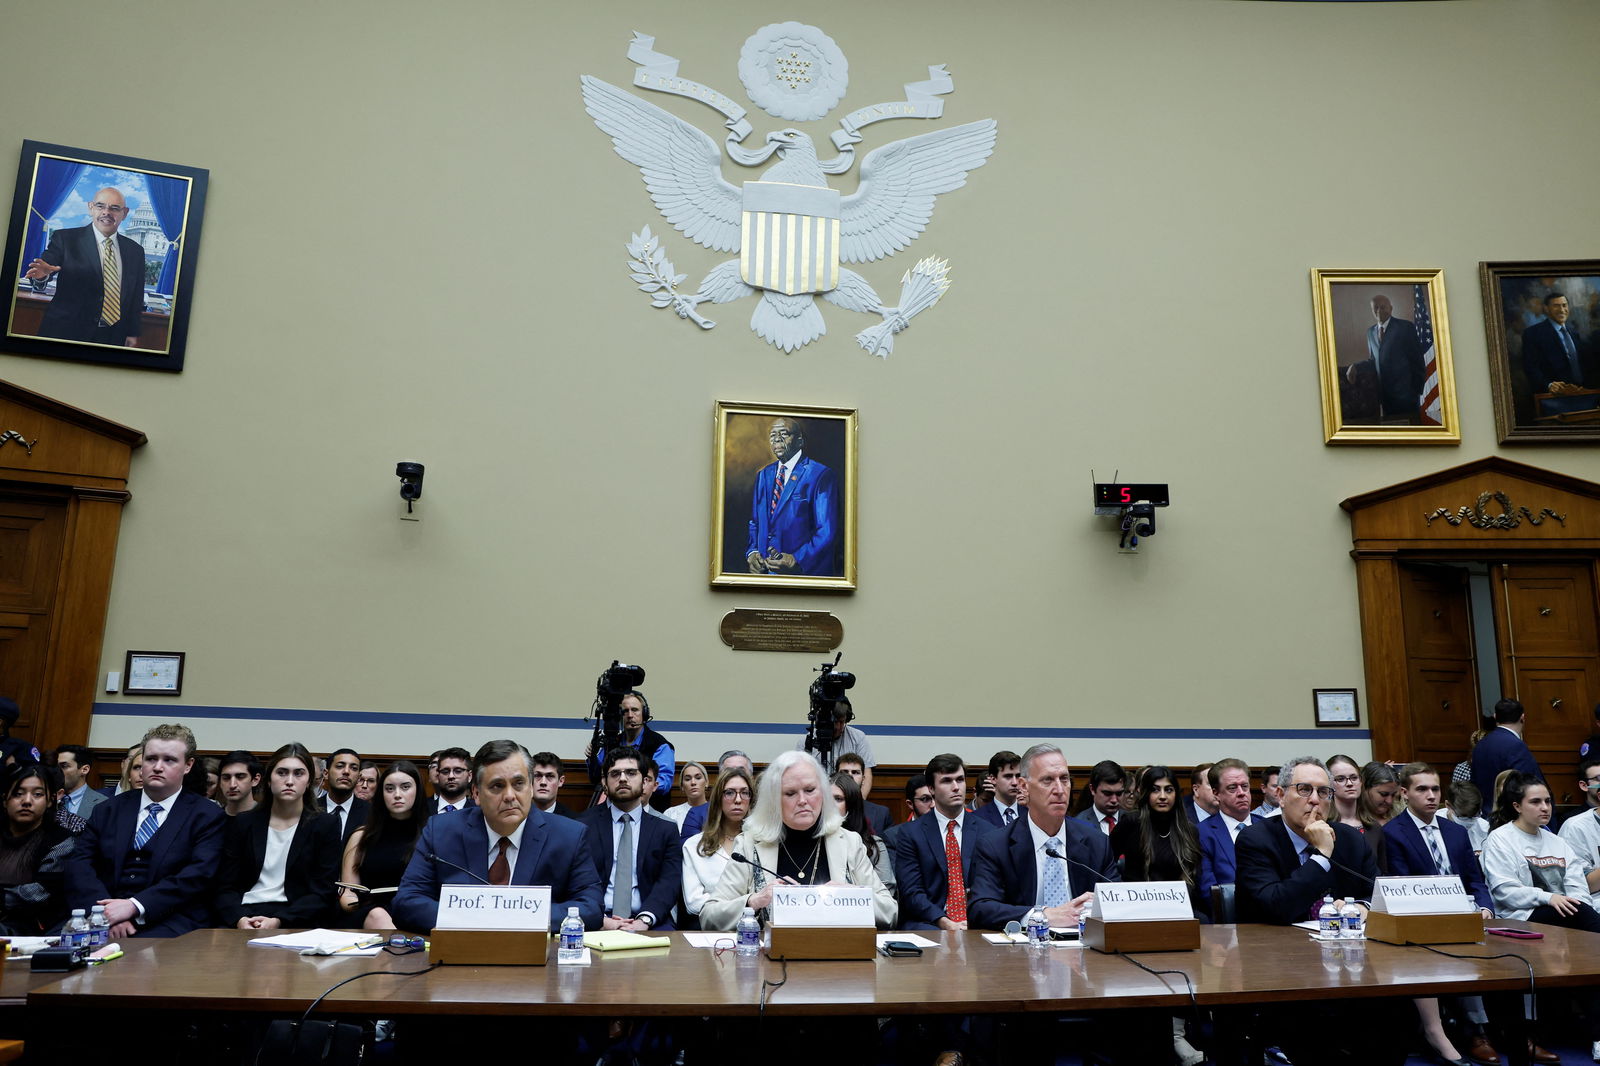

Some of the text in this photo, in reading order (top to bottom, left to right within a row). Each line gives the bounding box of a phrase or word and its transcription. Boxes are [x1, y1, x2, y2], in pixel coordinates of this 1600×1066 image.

[1121, 487, 1131, 503] 5
[1100, 889, 1186, 904] Mr. Dubinsky
[1381, 883, 1465, 897] Prof. Gerhardt
[448, 894, 543, 913] Prof. Turley
[776, 893, 801, 906] Ms.
